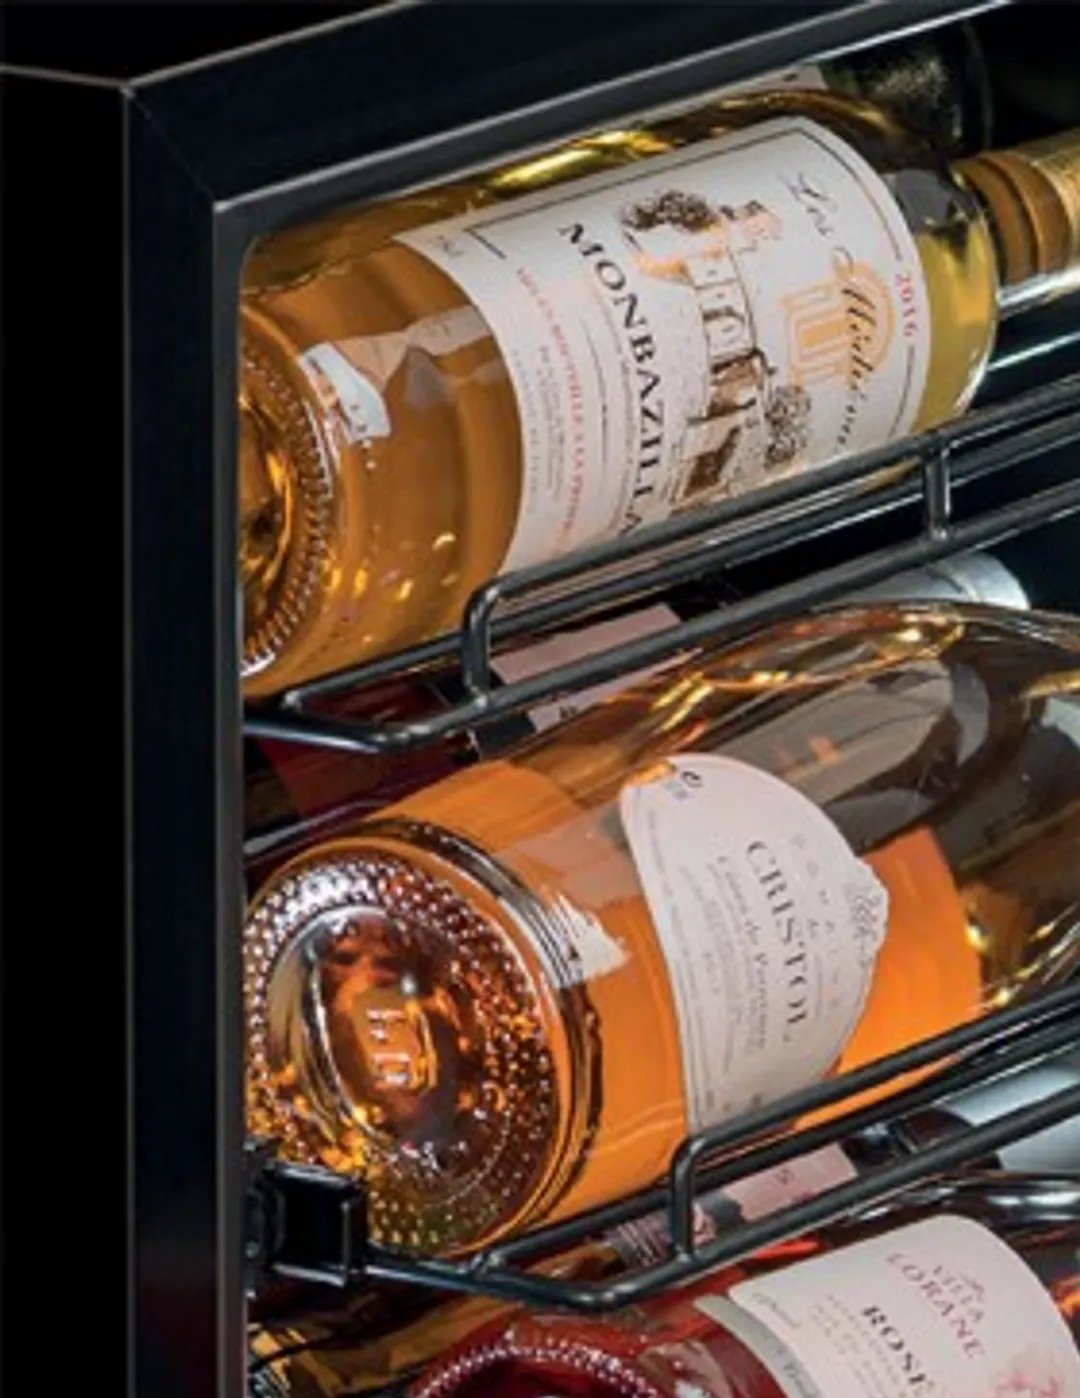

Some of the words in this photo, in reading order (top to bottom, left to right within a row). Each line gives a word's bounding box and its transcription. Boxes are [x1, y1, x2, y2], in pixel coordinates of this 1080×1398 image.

[893, 272, 918, 339] 2016
[746, 840, 809, 1044] CRISTOL
[885, 1252, 986, 1360] LORANE
